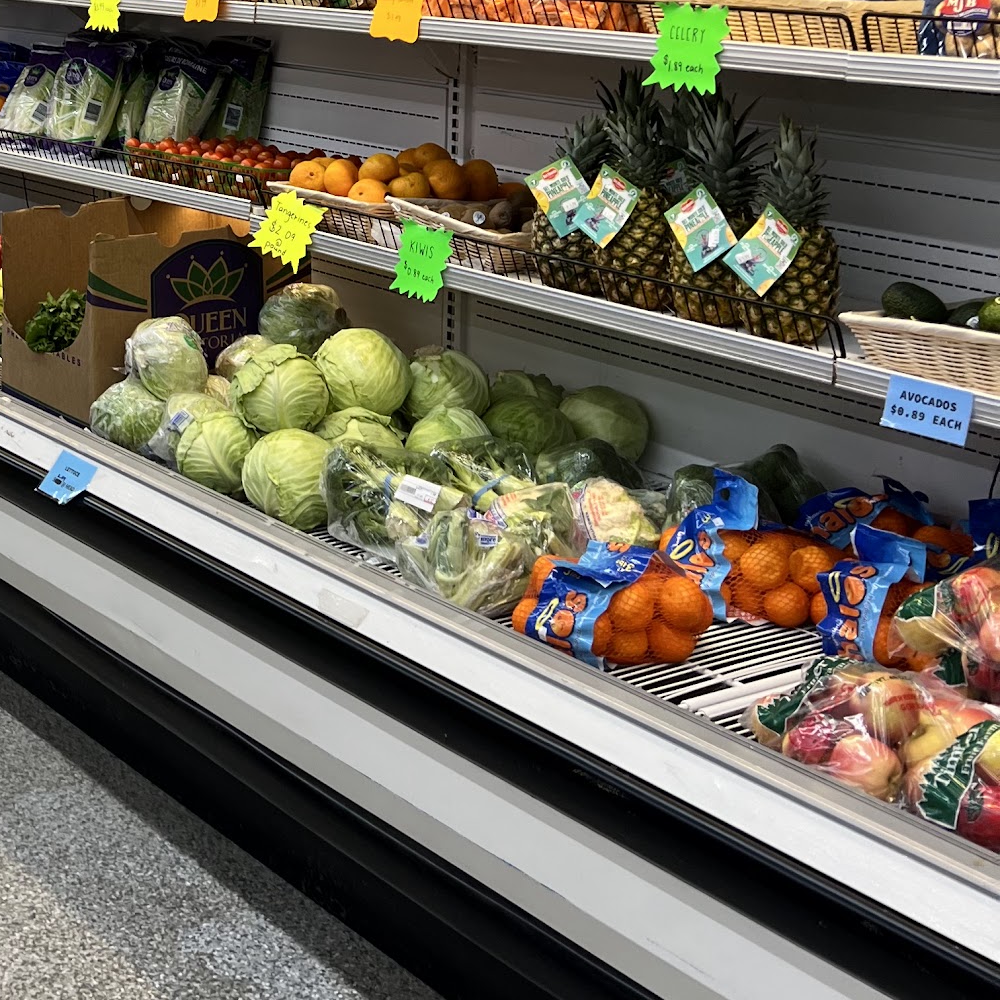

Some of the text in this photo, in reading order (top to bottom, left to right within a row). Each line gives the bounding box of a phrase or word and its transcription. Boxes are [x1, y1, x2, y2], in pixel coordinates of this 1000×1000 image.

[669, 25, 706, 44] CELERY
[685, 64, 704, 74] each
[275, 200, 312, 229] Tangerines
[264, 241, 288, 256] pound
[409, 240, 435, 259] KIWIS
[421, 274, 435, 284] each
[899, 390, 958, 412] AVOCADOS
[890, 404, 963, 431] $0.89 EACH
